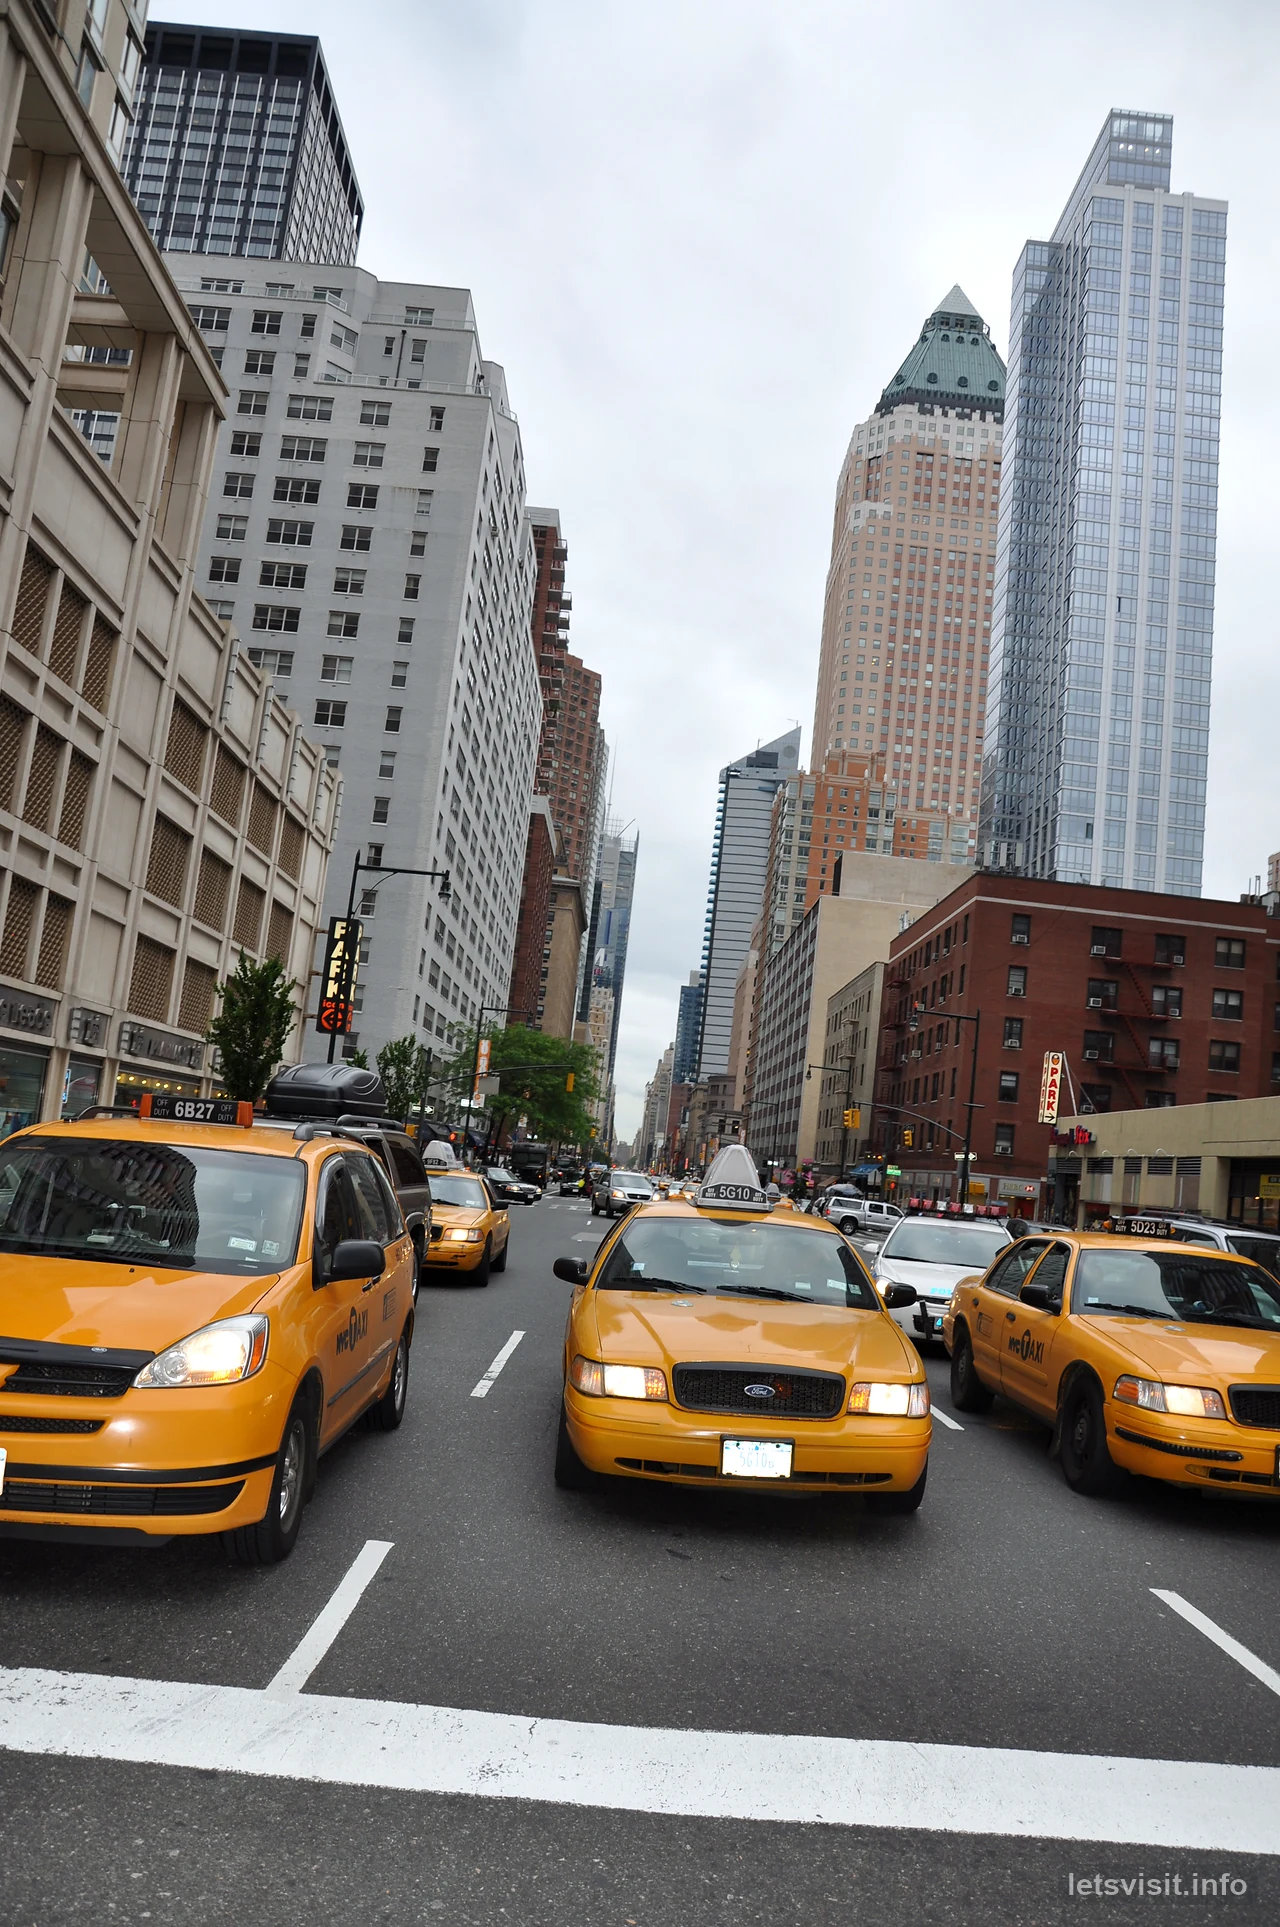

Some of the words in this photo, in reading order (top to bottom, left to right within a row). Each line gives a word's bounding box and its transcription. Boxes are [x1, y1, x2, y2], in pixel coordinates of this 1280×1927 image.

[1046, 1067, 1059, 1111] PARK
[157, 1098, 168, 1106] OFF
[154, 1108, 170, 1116] DUTY
[174, 1101, 214, 1120] 6B27
[221, 1104, 232, 1112] OFF
[217, 1113, 234, 1122] DUTY
[719, 1186, 750, 1200] 5G10
[1115, 1224, 1127, 1232] DUTY
[1130, 1220, 1156, 1235] 5D23
[751, 1387, 768, 1396] Ford
